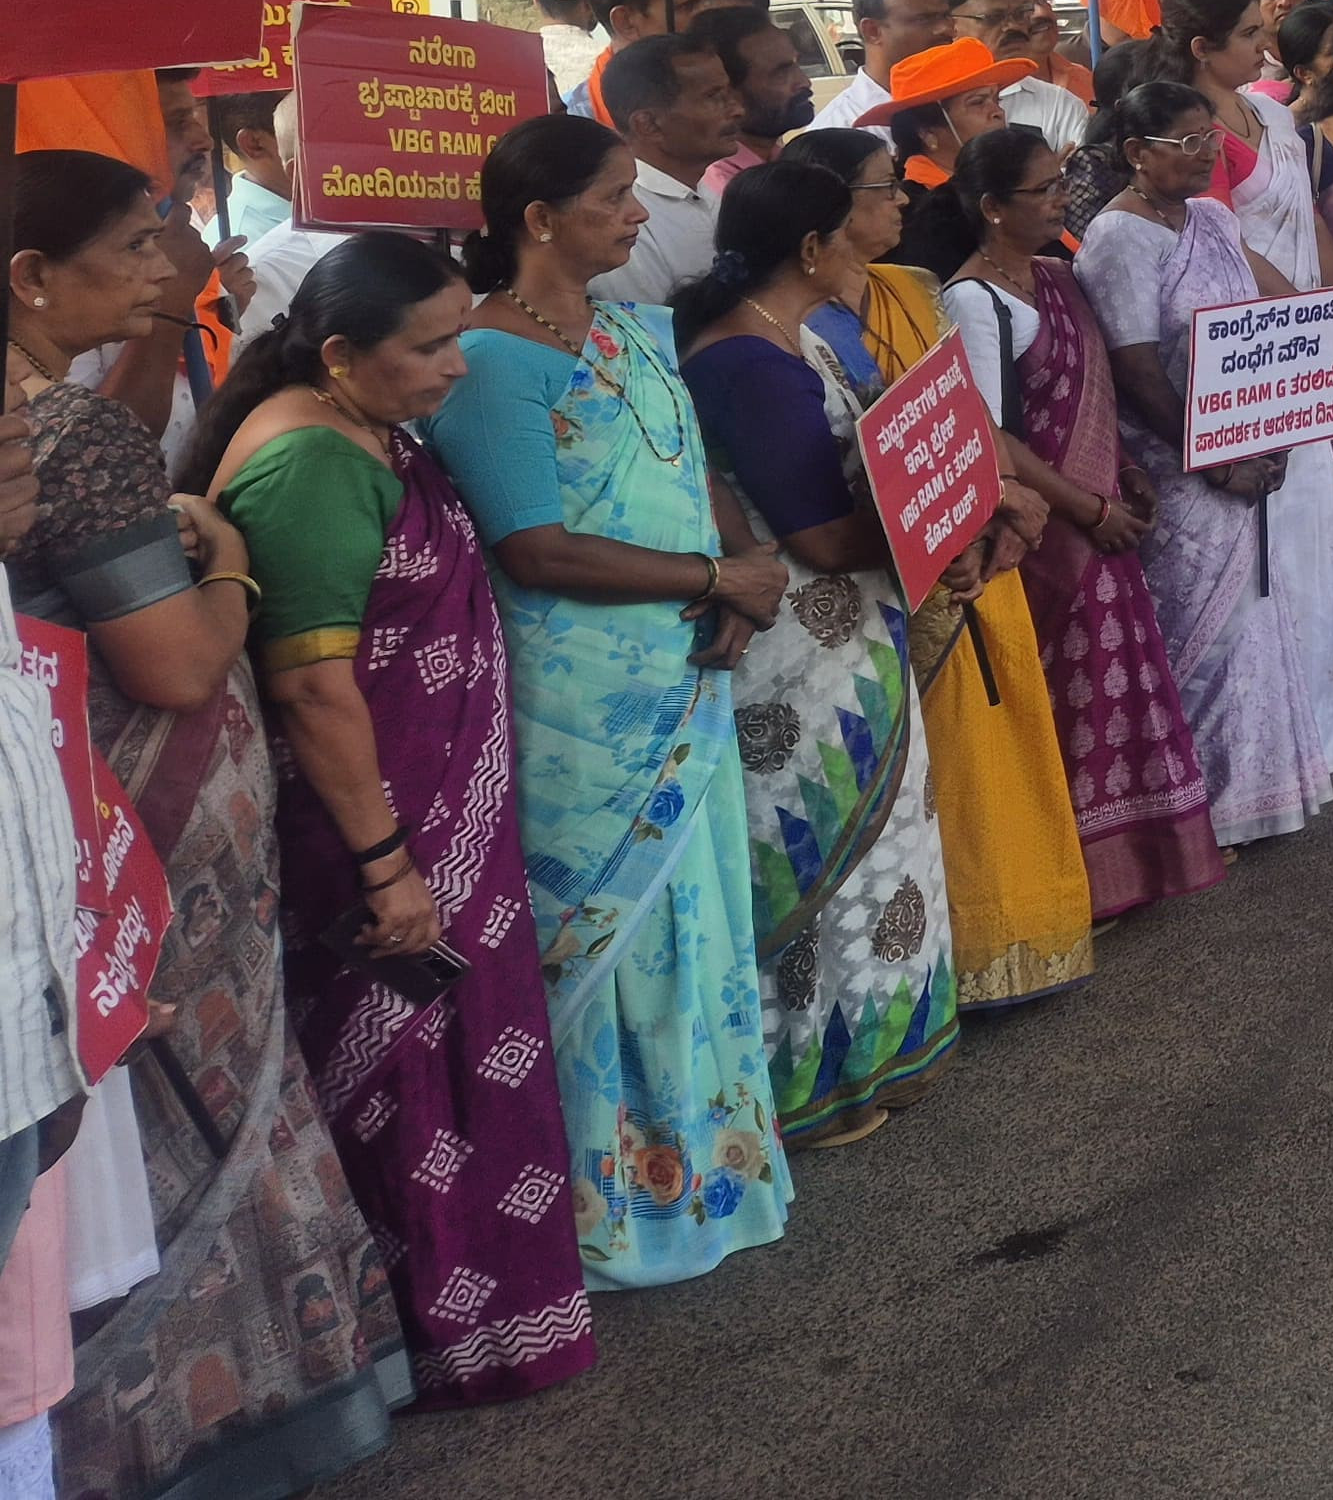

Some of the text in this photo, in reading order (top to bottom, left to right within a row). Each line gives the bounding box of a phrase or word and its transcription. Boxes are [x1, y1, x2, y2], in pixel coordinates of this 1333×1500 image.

[409, 35, 476, 69] ನರೇಗಾ
[389, 128, 482, 156] VBG RAM
[322, 165, 460, 200] ಮೋದಿಯವರ
[1221, 334, 1320, 374] ದಂಧೆಗೆ ಮೌನ
[1198, 390, 1232, 414] VBG
[1237, 382, 1271, 407] RAM
[1276, 378, 1286, 398] G
[899, 475, 945, 533] VBG RAM
